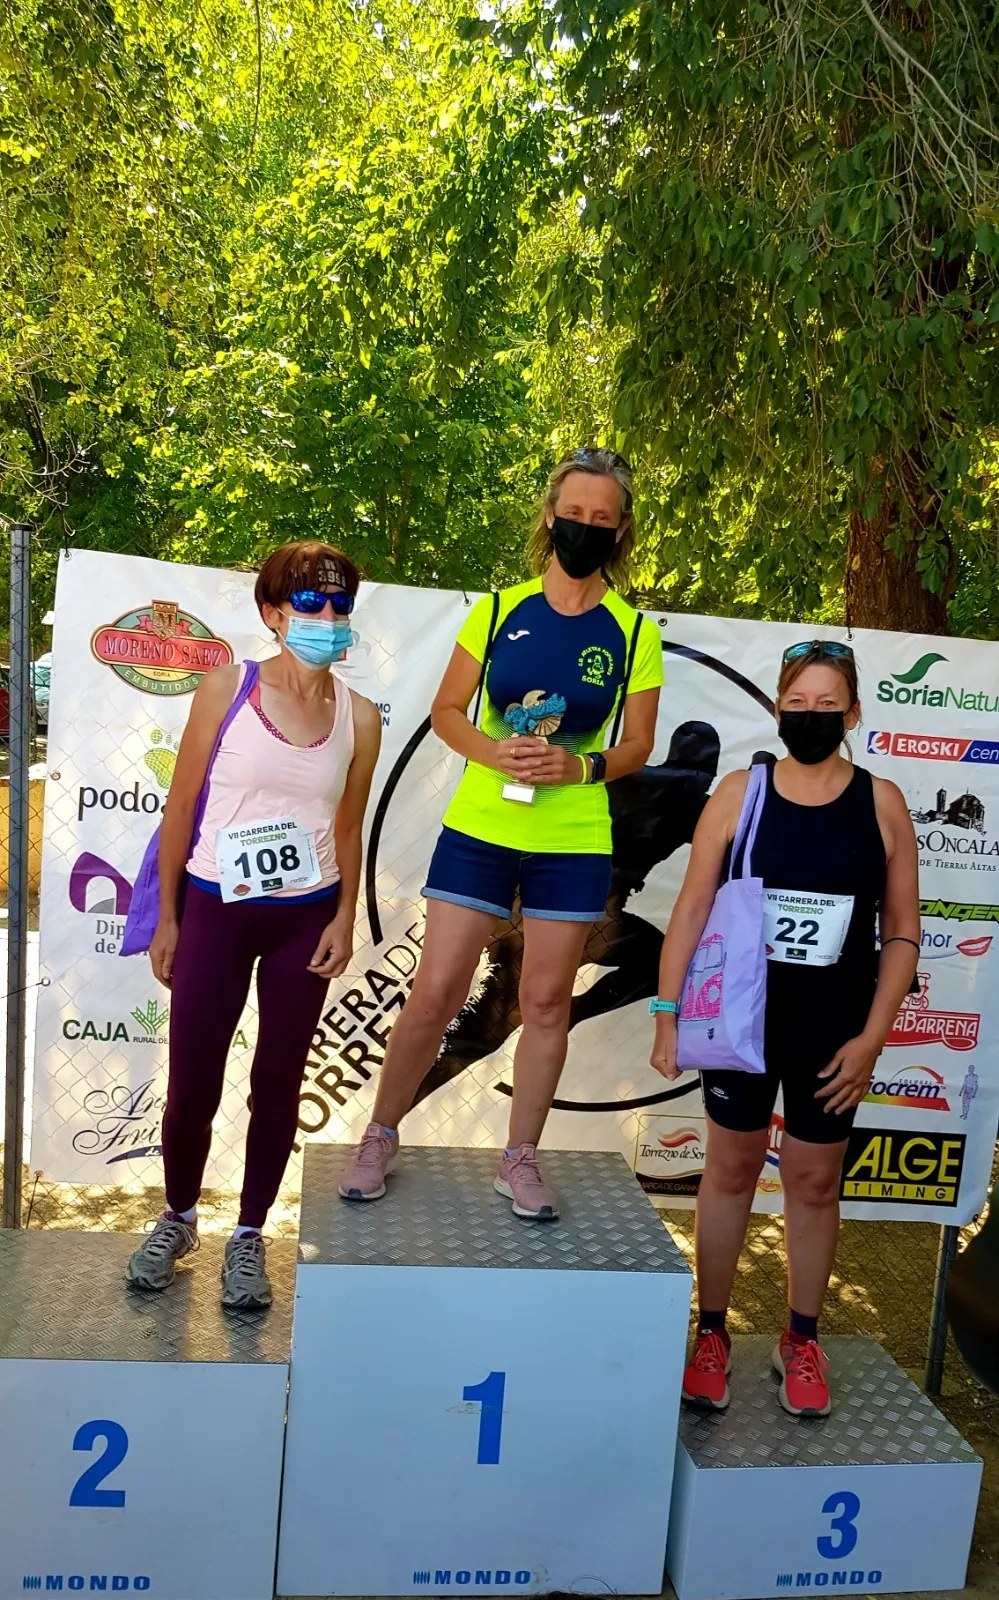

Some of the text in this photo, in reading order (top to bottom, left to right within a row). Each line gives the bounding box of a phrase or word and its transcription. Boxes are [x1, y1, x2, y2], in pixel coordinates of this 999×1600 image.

[104, 636, 223, 667] MORENO SAEZ
[124, 669, 199, 692] EMBUTIDOS
[581, 675, 605, 687] SORIA
[876, 680, 999, 713] SoriaNatu
[896, 738, 960, 757] EROSKI
[228, 821, 298, 840] VII CARRERA DEL
[240, 832, 288, 847] TORREZNO
[234, 844, 301, 879] 108
[970, 862, 997, 872] ALTAS
[767, 893, 836, 907] VII CARRERA DEL
[778, 904, 824, 915] TORREZNO
[774, 917, 820, 946] 22
[95, 938, 116, 954] de
[62, 1019, 130, 1043] CAJA
[133, 1036, 156, 1044] RURAL
[679, 1145, 691, 1158] de
[846, 1135, 962, 1184] ALGE
[664, 1182, 673, 1190] DE
[853, 1182, 947, 1199] TIMING
[462, 1371, 506, 1465] 1
[69, 1419, 129, 1508] 2
[816, 1491, 861, 1560] 3
[46, 1575, 151, 1591] MONDO
[434, 1570, 531, 1585] MONDO
[796, 1570, 882, 1587] MONDO
